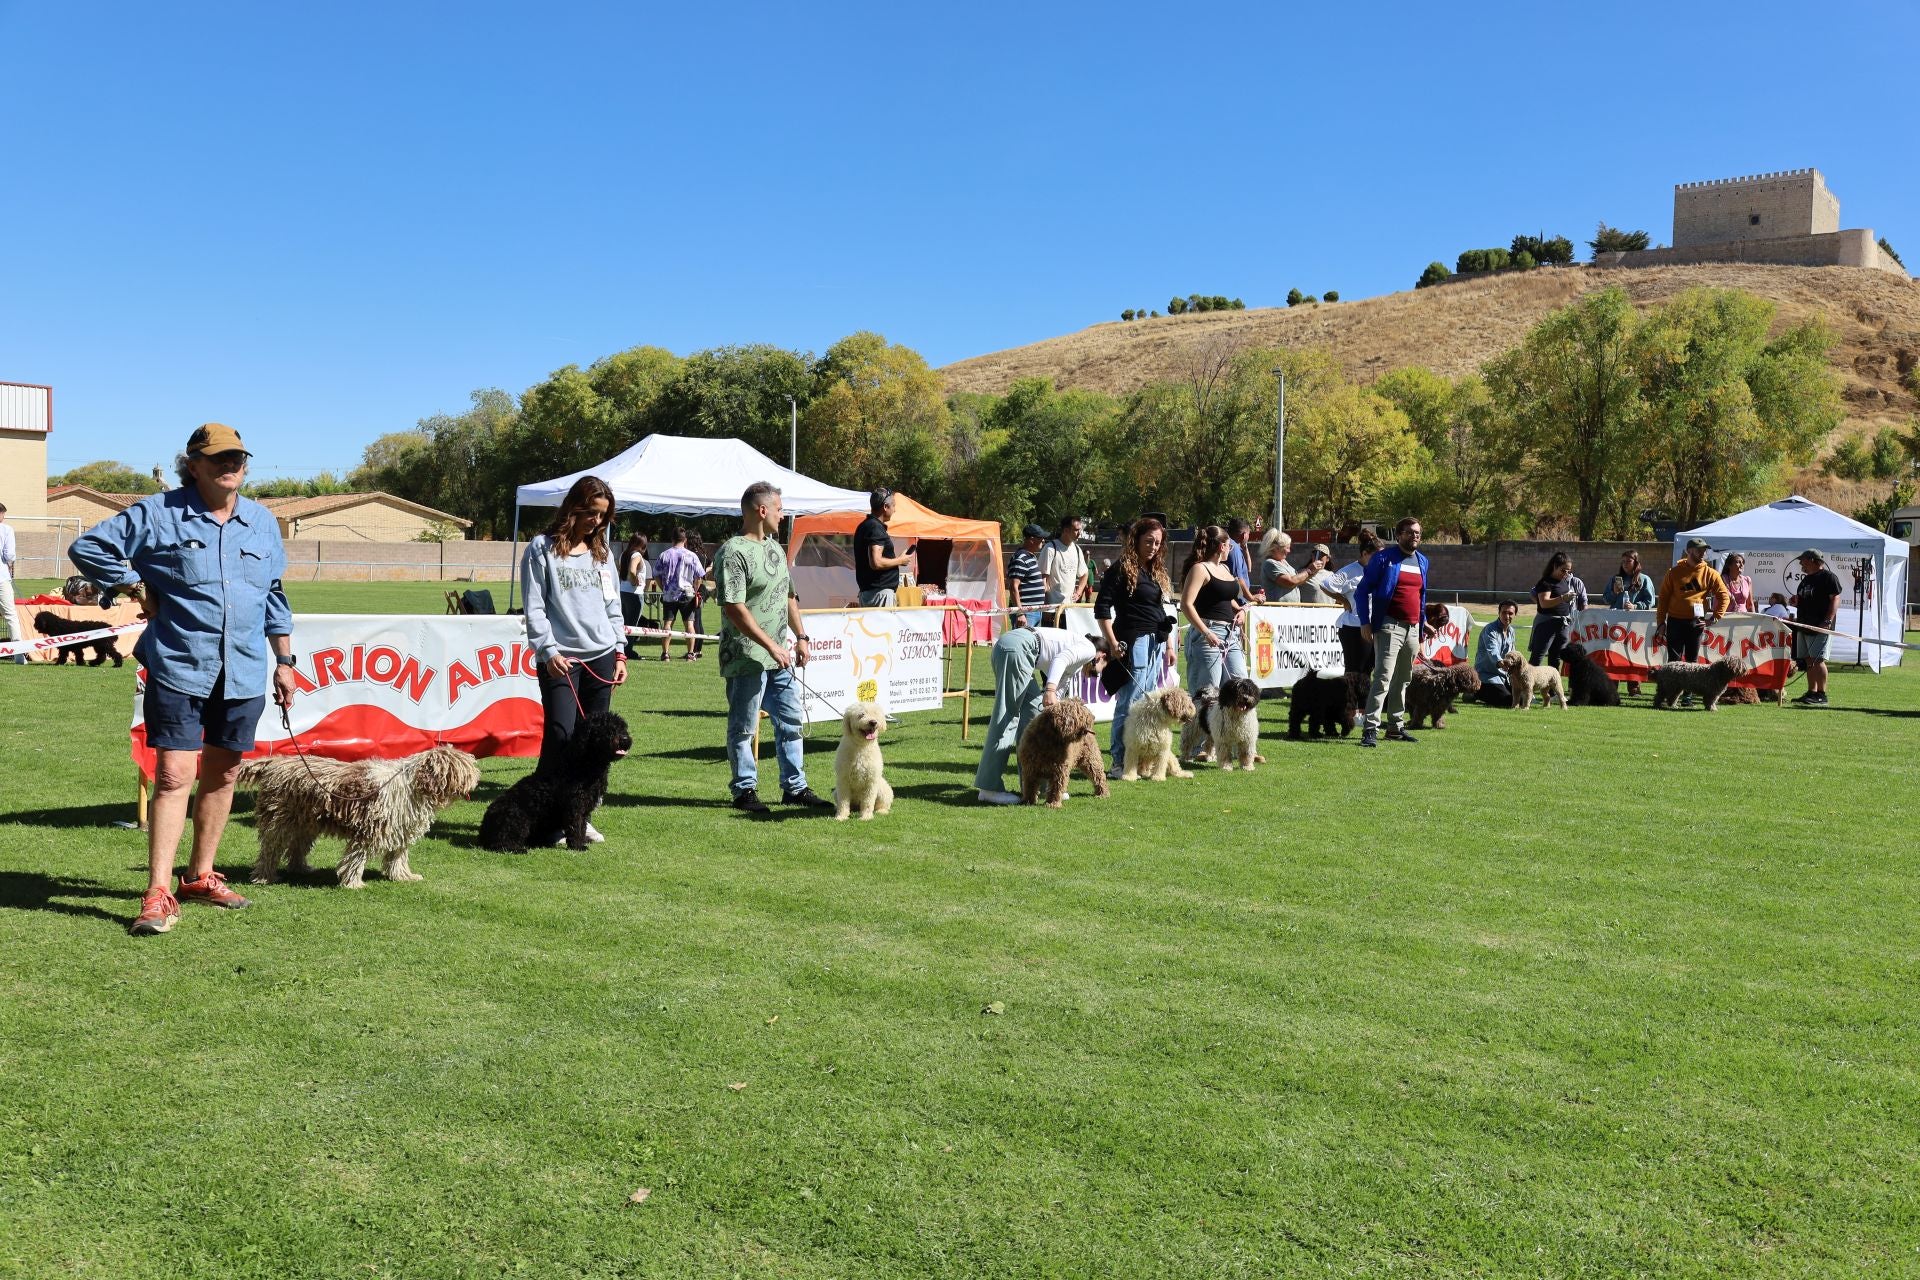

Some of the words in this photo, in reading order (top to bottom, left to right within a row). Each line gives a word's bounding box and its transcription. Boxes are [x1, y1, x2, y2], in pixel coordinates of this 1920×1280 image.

[1831, 554, 1860, 562] Educado
[898, 628, 941, 643] Hermanos
[1278, 625, 1327, 643] AYUNTAMIENTO
[1570, 622, 1645, 653] ARION
[34, 635, 89, 649] ARION
[1322, 650, 1345, 668] CAMPO
[823, 689, 845, 698] CAMPOS
